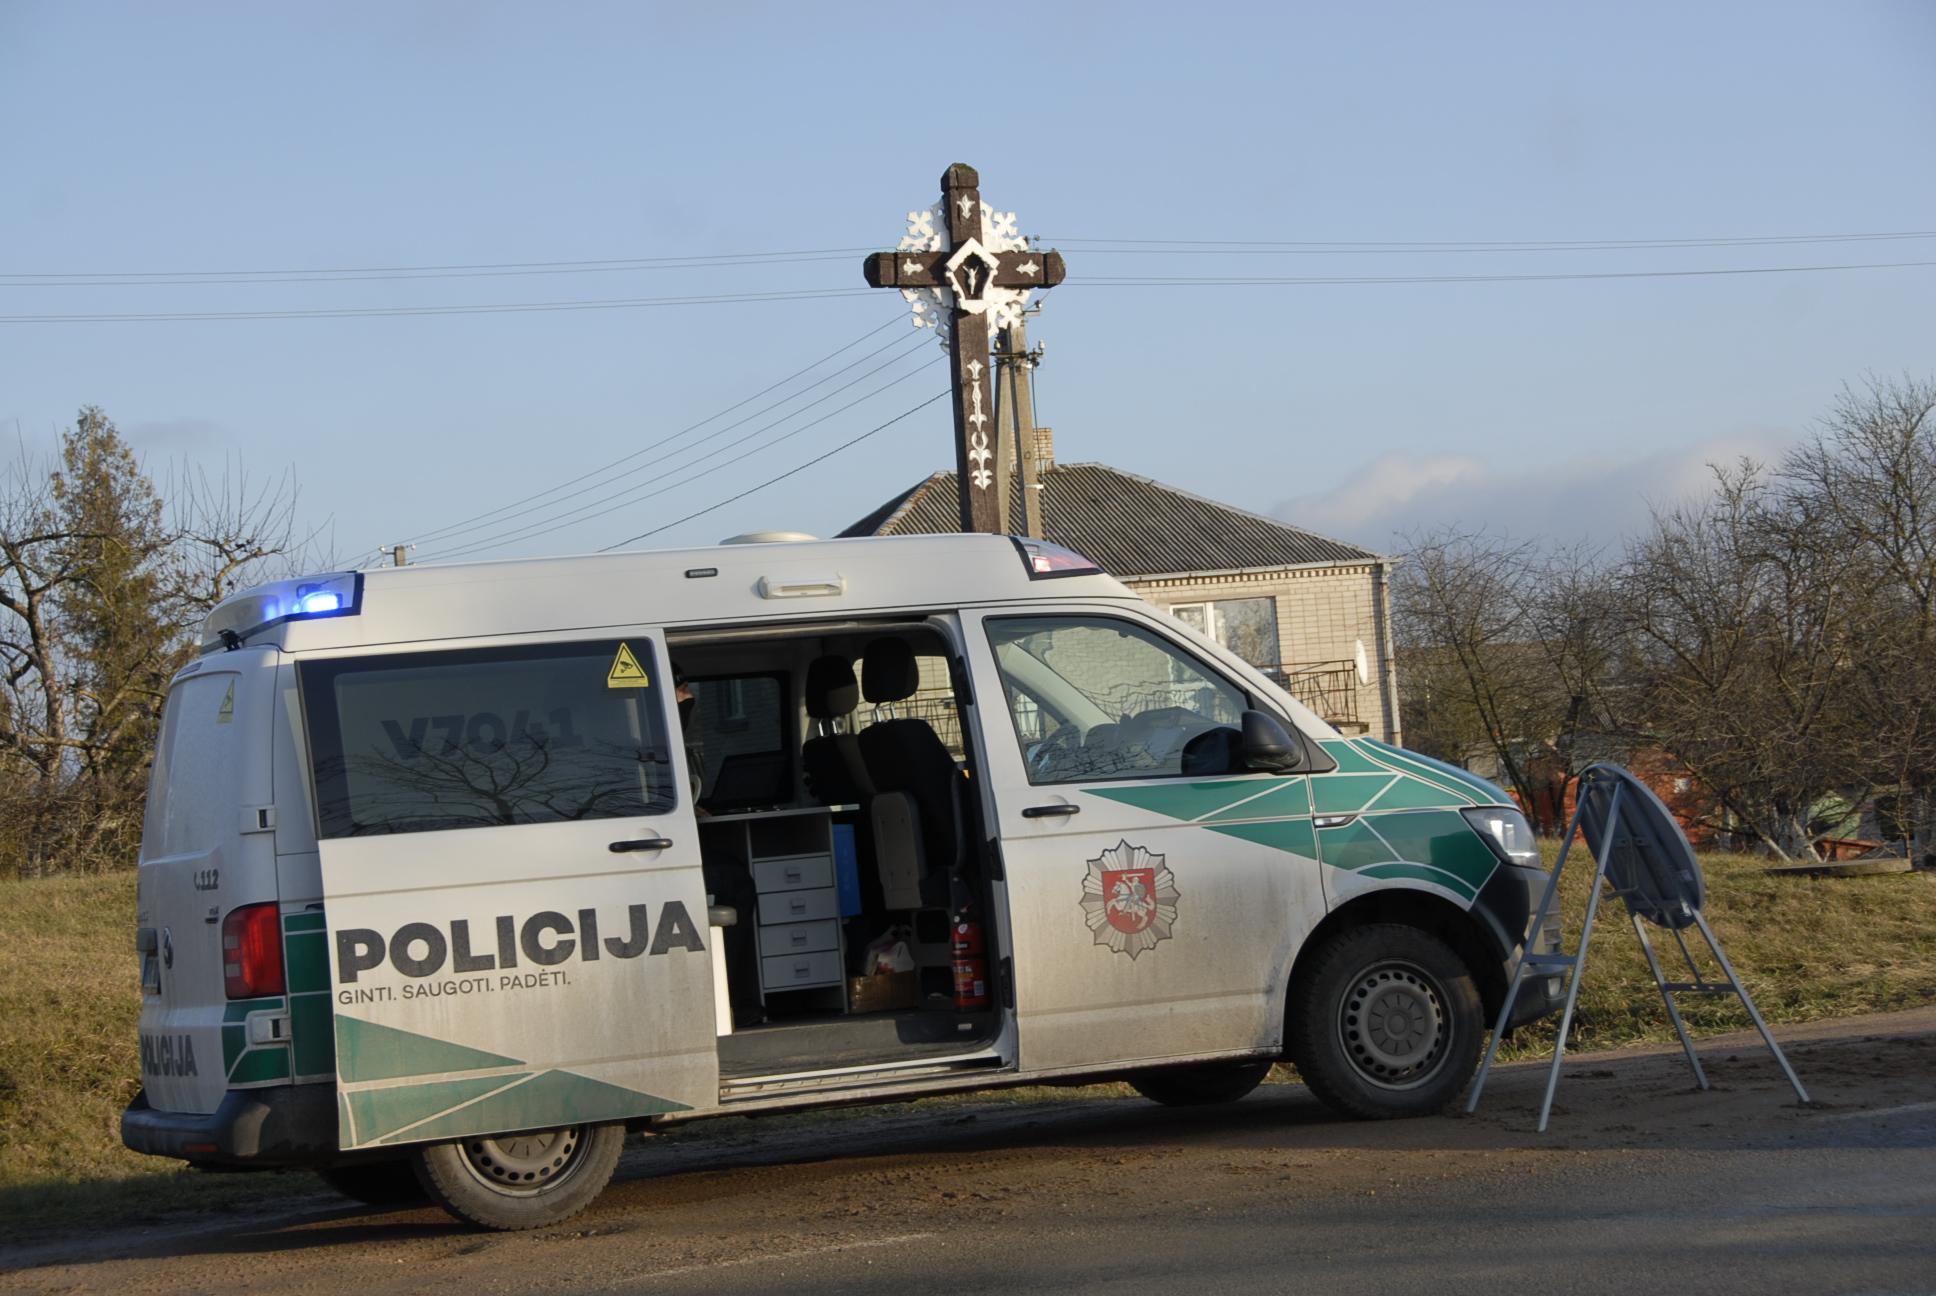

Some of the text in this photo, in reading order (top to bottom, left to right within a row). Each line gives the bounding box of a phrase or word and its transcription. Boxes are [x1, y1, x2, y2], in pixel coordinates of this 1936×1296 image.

[381, 707, 584, 760] V7041
[201, 868, 219, 890] 112
[335, 900, 706, 983] POLICIJA
[338, 968, 571, 1005] GINTI. SAUGOTI. PADĖTI.
